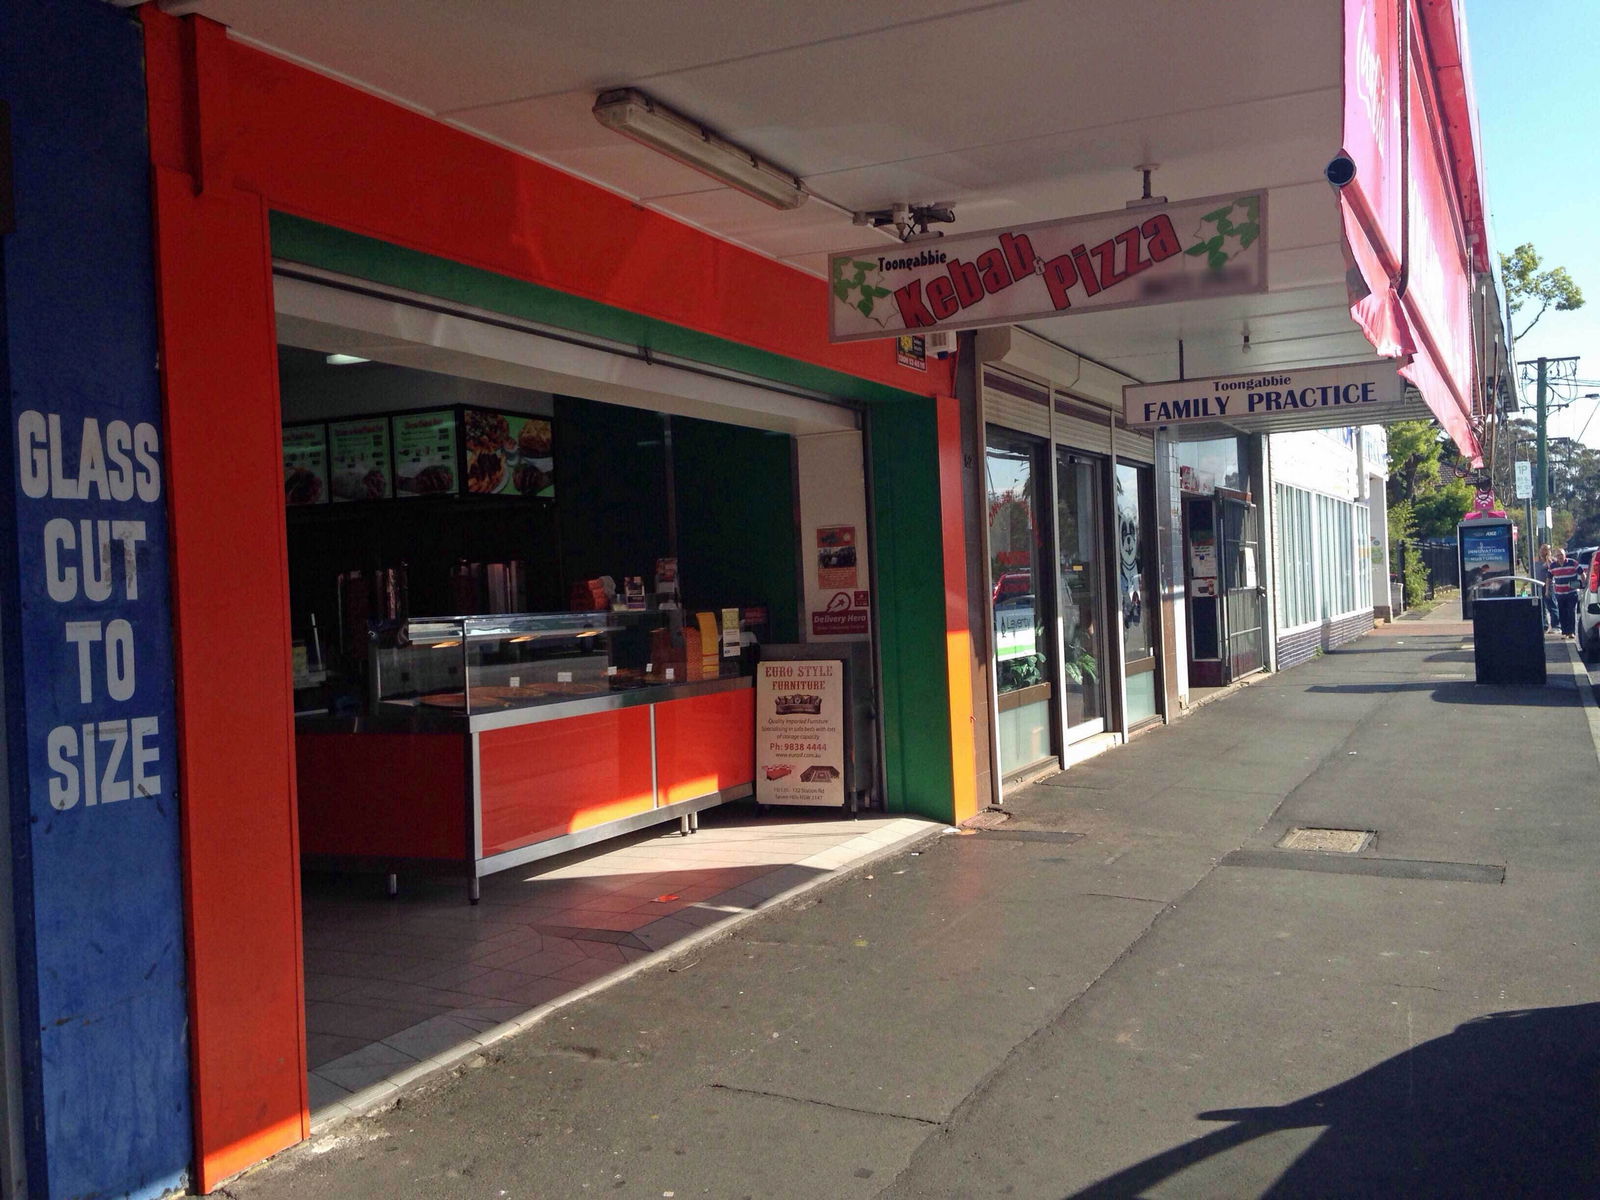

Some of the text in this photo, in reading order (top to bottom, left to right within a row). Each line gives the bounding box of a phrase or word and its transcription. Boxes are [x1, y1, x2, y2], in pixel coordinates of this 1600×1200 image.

[878, 249, 947, 273] Toongabbie
[893, 231, 1036, 329] Kebab
[1043, 213, 1182, 311] Pizza
[1213, 375, 1291, 392] Toongabbie
[1144, 382, 1378, 421] FAMILY PRACTICE
[18, 409, 161, 503] GLASS
[43, 517, 146, 602] CUT
[814, 614, 867, 625] Delivery Hero
[65, 618, 135, 704] TO
[765, 665, 833, 678] EURO STYLE
[772, 680, 826, 691] FURNITURE
[770, 742, 827, 751] Ph: 9838 4444
[47, 716, 162, 811] SIZE
